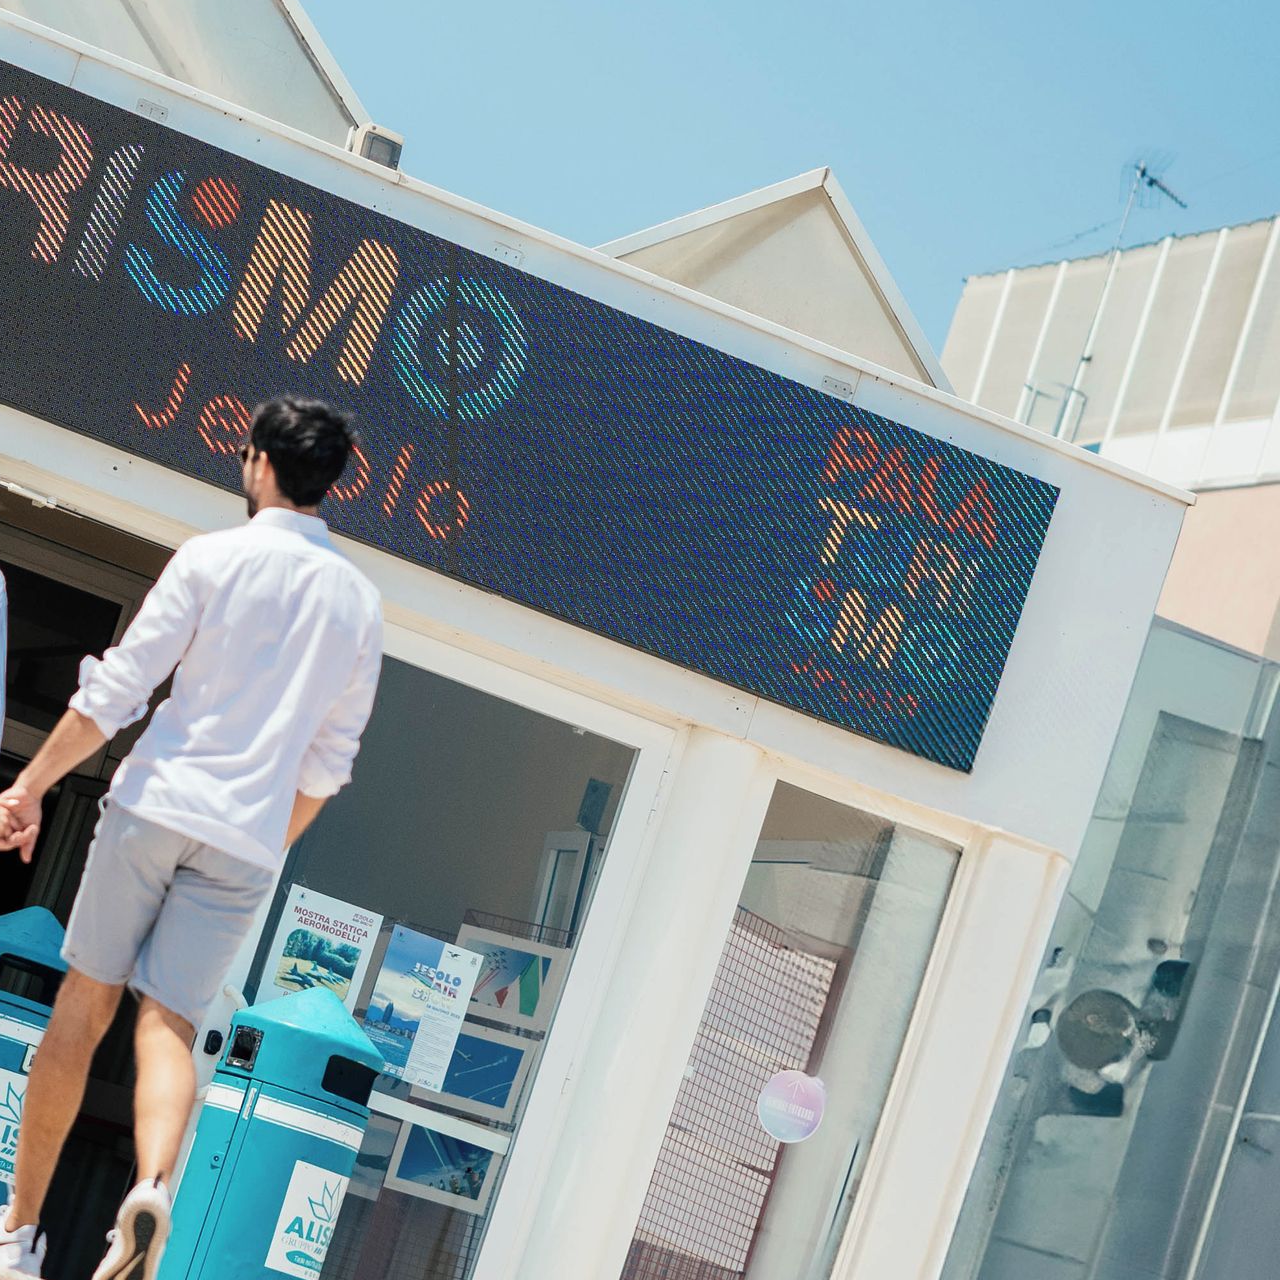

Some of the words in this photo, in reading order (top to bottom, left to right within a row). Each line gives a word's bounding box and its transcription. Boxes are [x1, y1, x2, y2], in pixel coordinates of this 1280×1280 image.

[133, 363, 470, 540] Jeolo
[821, 425, 998, 549] PALA
[818, 496, 985, 617] TURI
[293, 905, 330, 925] MOSTRA
[332, 917, 369, 939] STATICA
[297, 915, 361, 944] AEROMODELLI
[414, 962, 462, 987] JESOLO
[432, 982, 459, 1000] AIR
